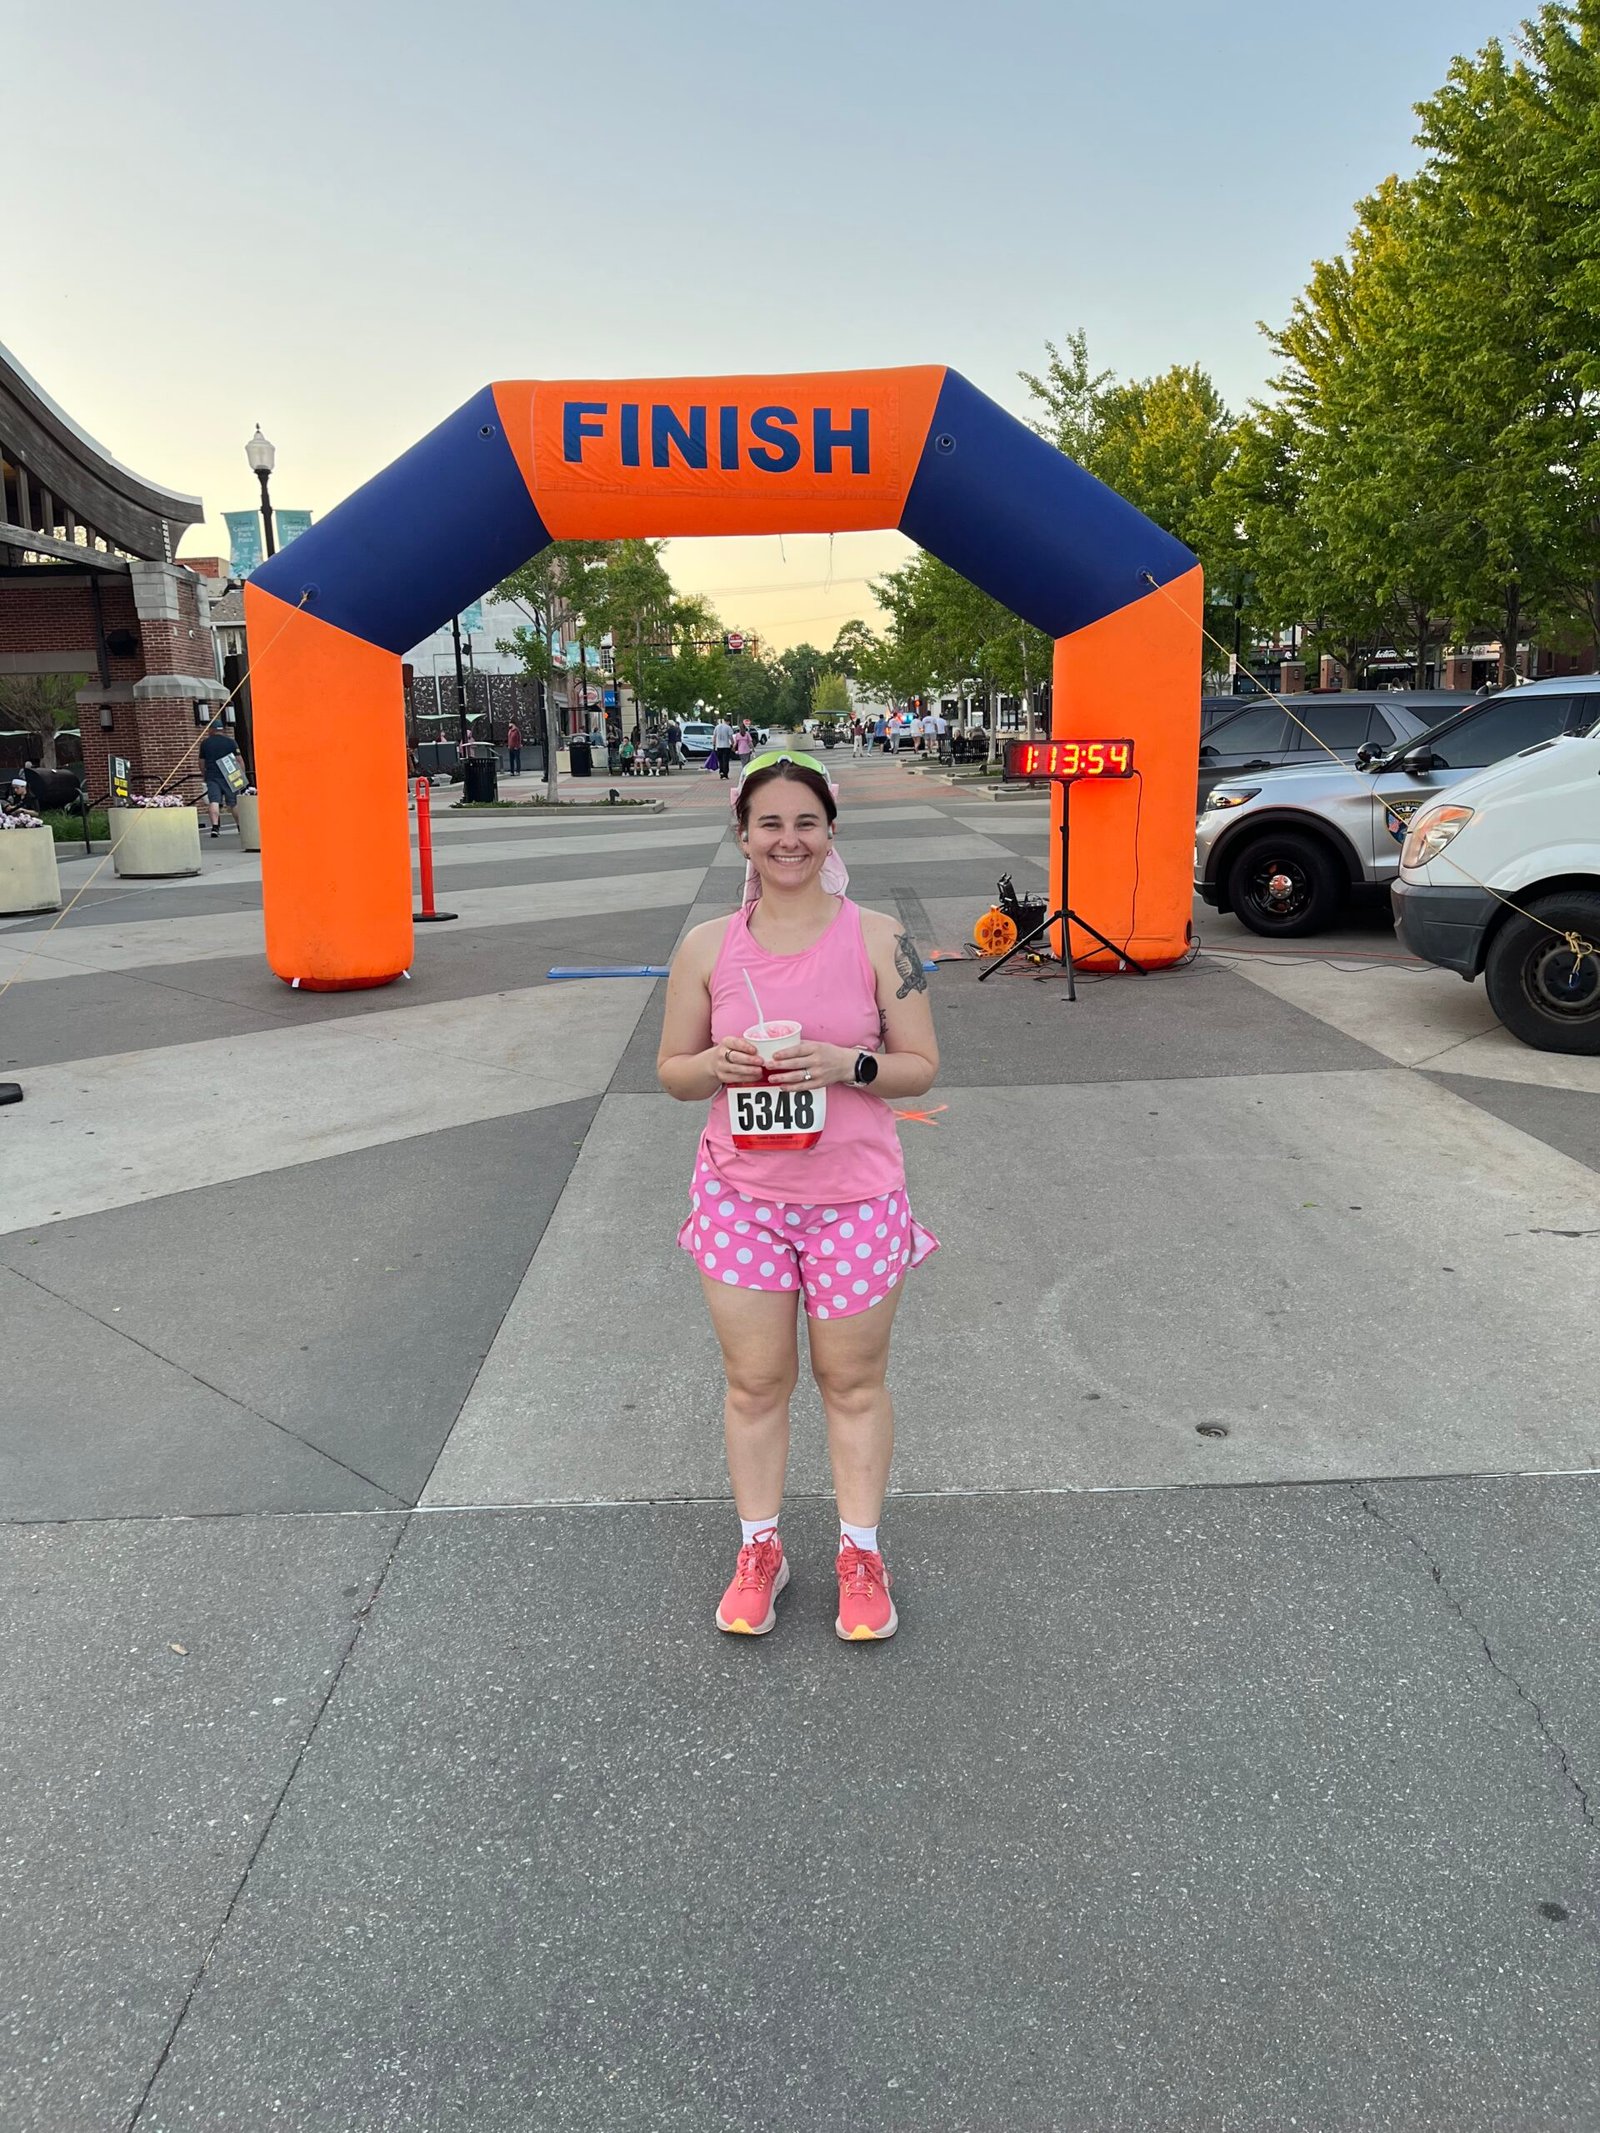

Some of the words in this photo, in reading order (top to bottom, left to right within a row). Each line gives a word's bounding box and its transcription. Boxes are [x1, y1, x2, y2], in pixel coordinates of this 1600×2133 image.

[563, 401, 871, 474] FINISH
[1026, 744, 1128, 774] 1:13:54
[736, 1090, 815, 1132] 5348
